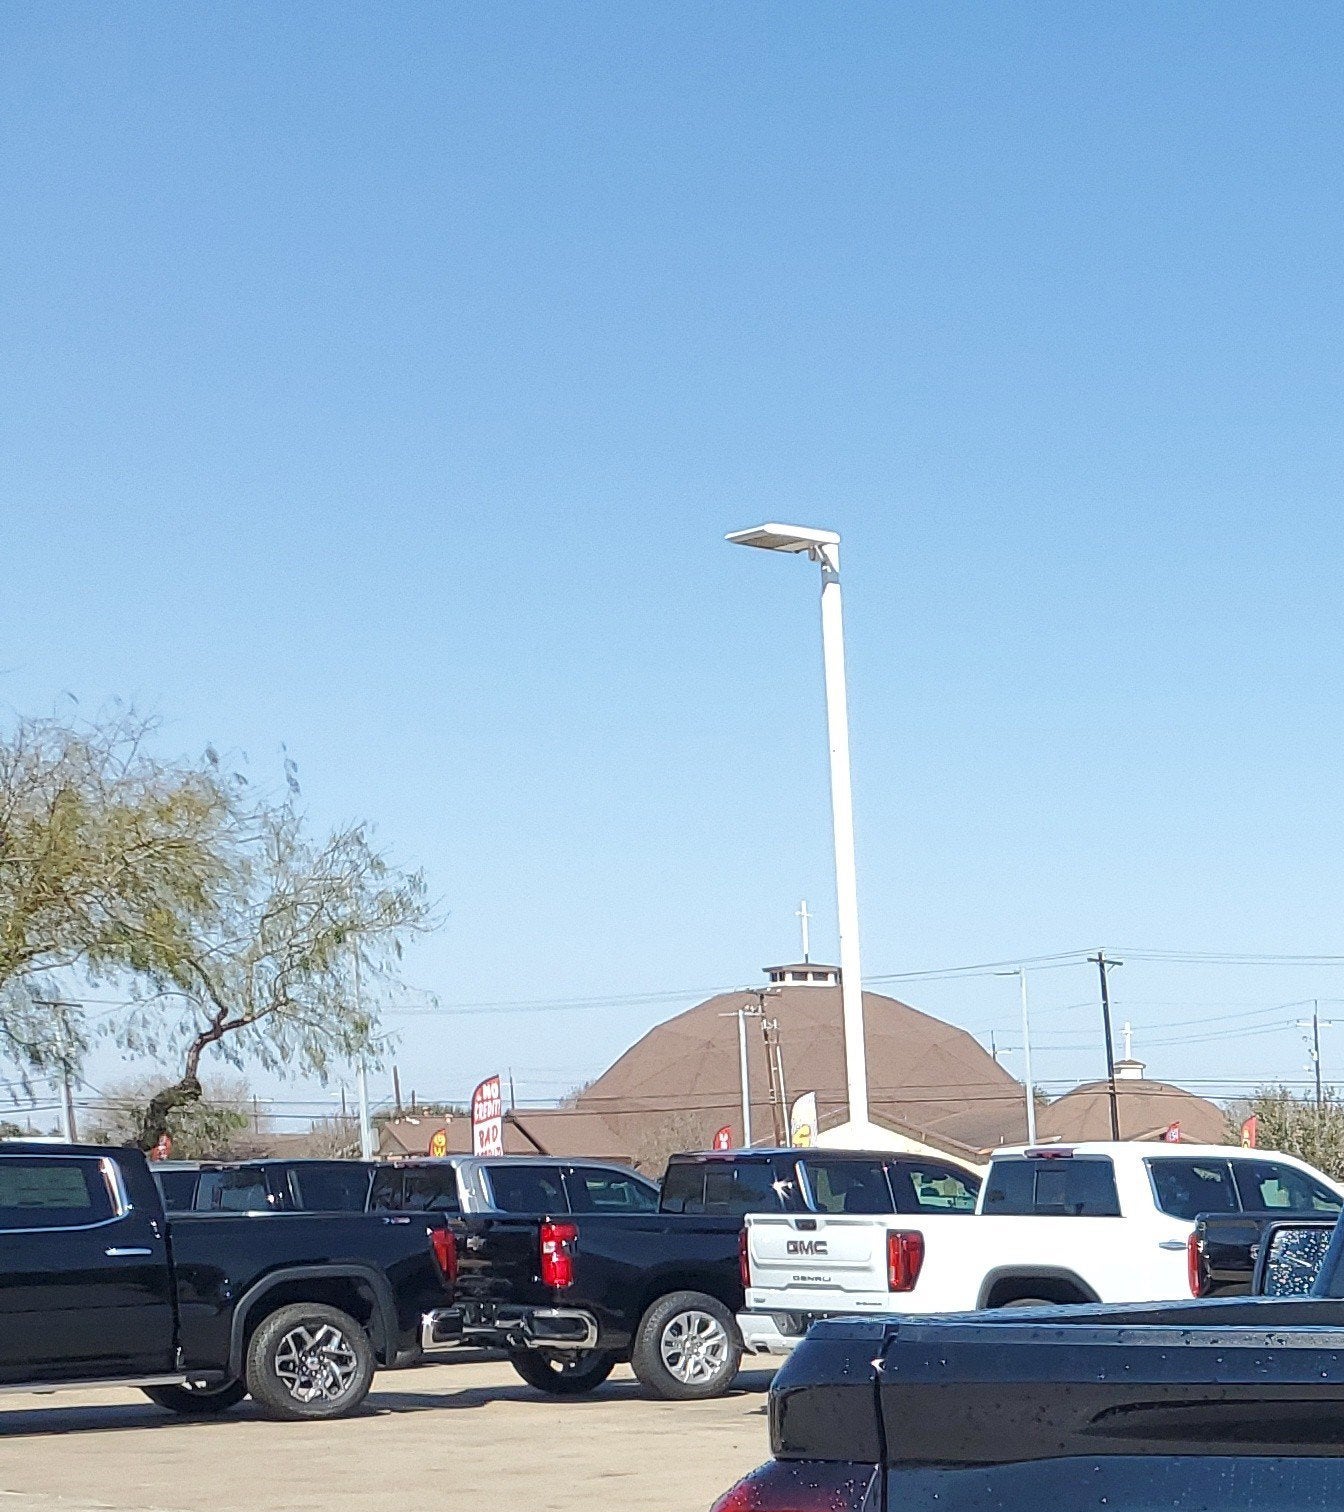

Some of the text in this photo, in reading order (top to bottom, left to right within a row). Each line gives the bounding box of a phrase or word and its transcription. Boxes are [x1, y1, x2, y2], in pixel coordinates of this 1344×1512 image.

[482, 1082, 500, 1099] NO
[479, 1125, 499, 1149] BAD
[786, 1240, 828, 1256] GMC
